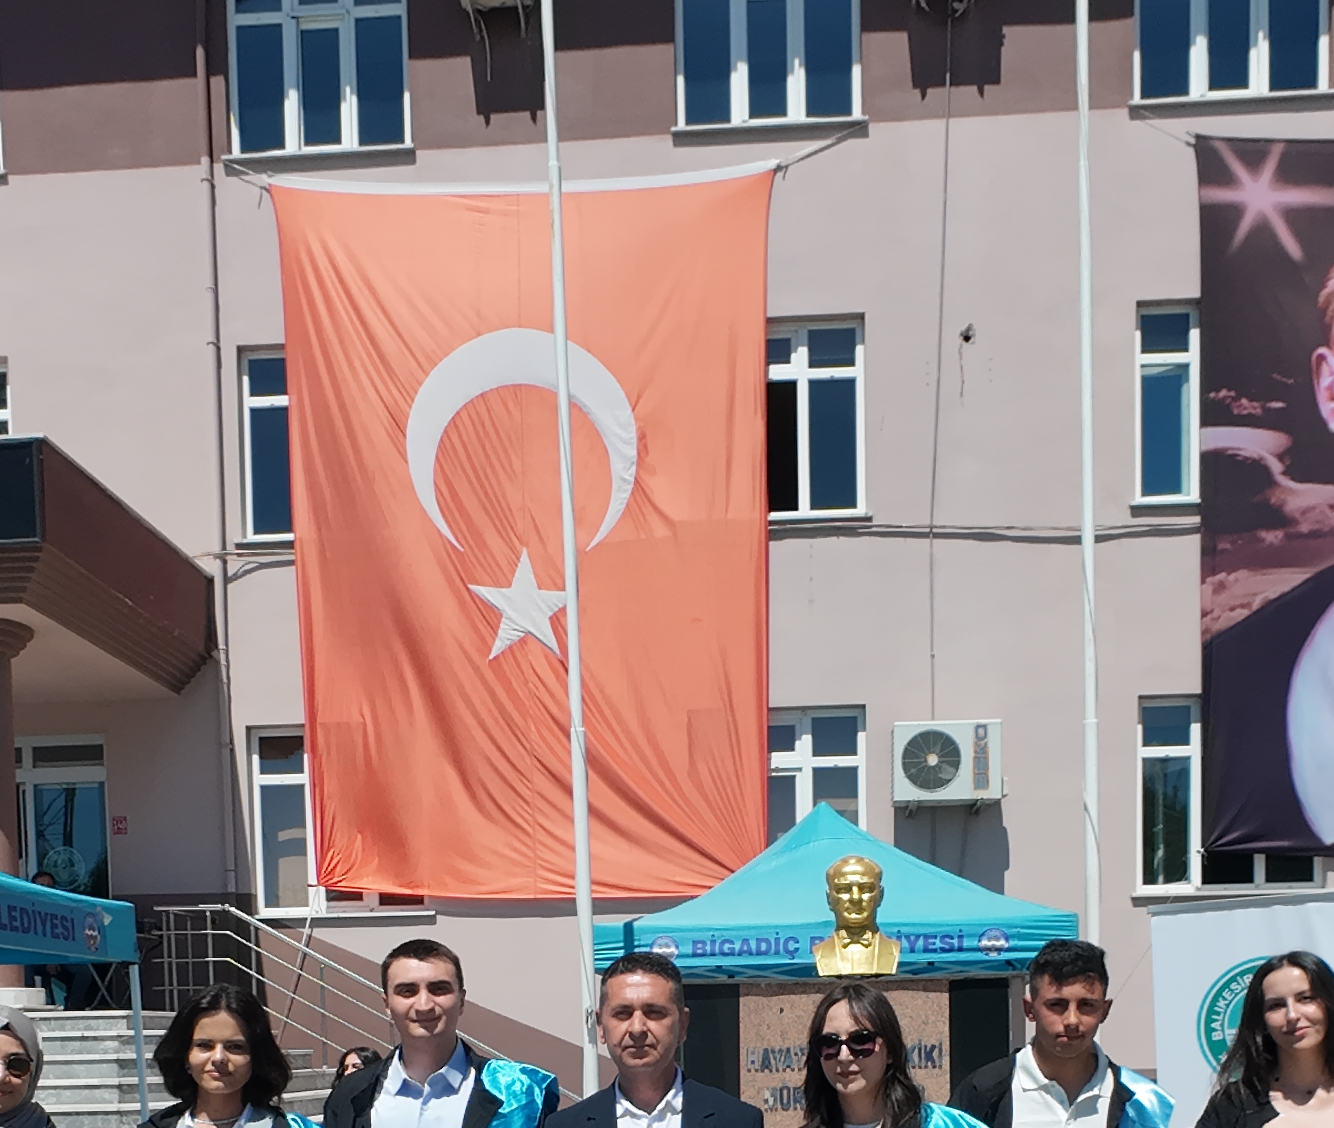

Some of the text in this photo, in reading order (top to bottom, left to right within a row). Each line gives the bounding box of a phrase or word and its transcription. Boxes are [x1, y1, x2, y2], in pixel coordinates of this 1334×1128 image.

[691, 931, 801, 960] BİGADİÇ
[809, 928, 965, 955] BİYESİ
[1210, 973, 1254, 1041] BALIKESİR
[745, 1045, 809, 1073] HAYAT
